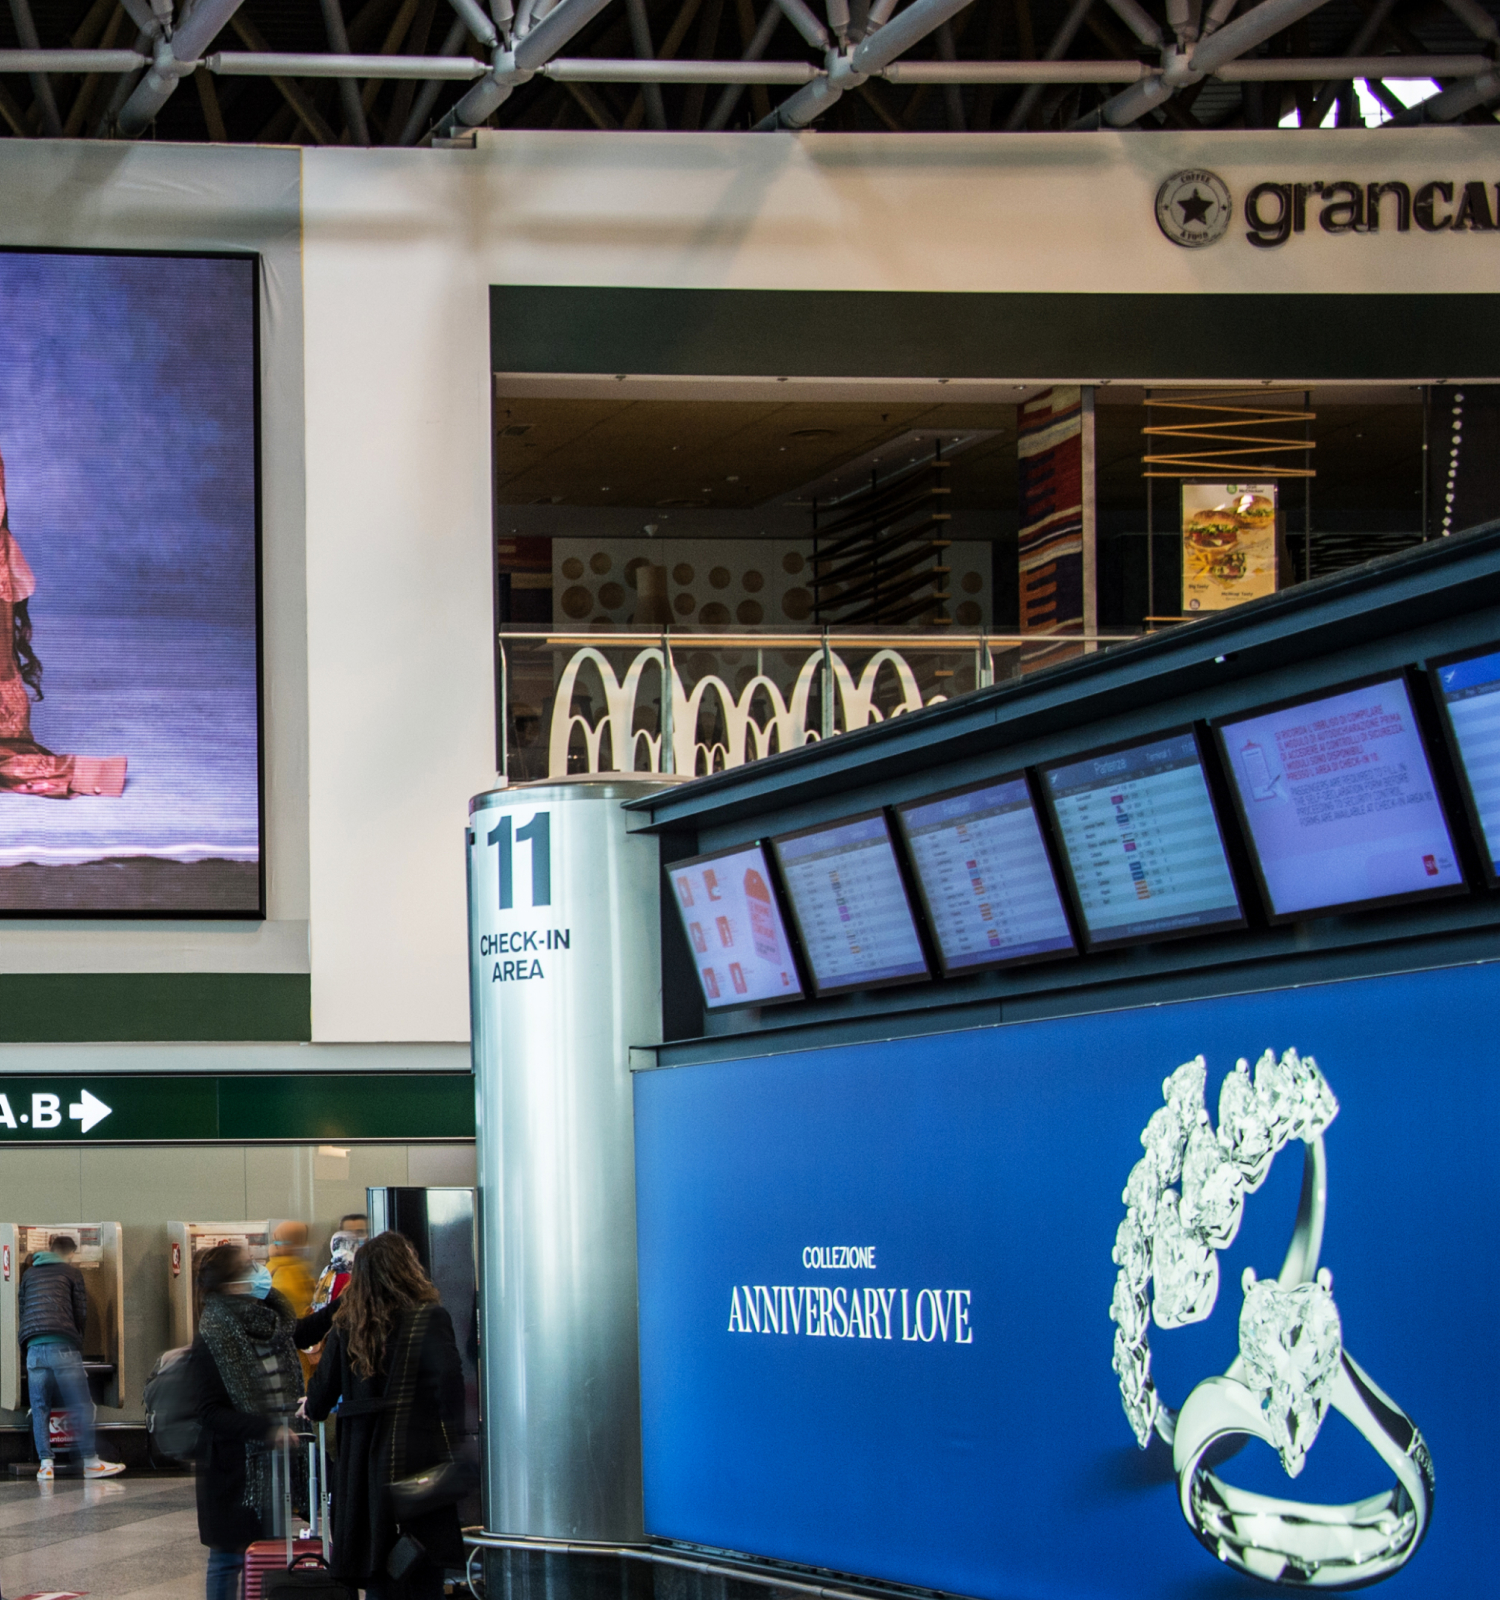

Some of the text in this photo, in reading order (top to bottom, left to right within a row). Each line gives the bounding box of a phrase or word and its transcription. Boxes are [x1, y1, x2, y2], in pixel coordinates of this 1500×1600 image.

[1245, 180, 1500, 248] granCA
[487, 812, 551, 910] 11
[480, 929, 570, 956] CHECK-IN
[492, 959, 544, 982] AREA
[803, 1247, 876, 1269] COLLEZIONE
[728, 1285, 972, 1344] ANNIVERSARY LOVE
